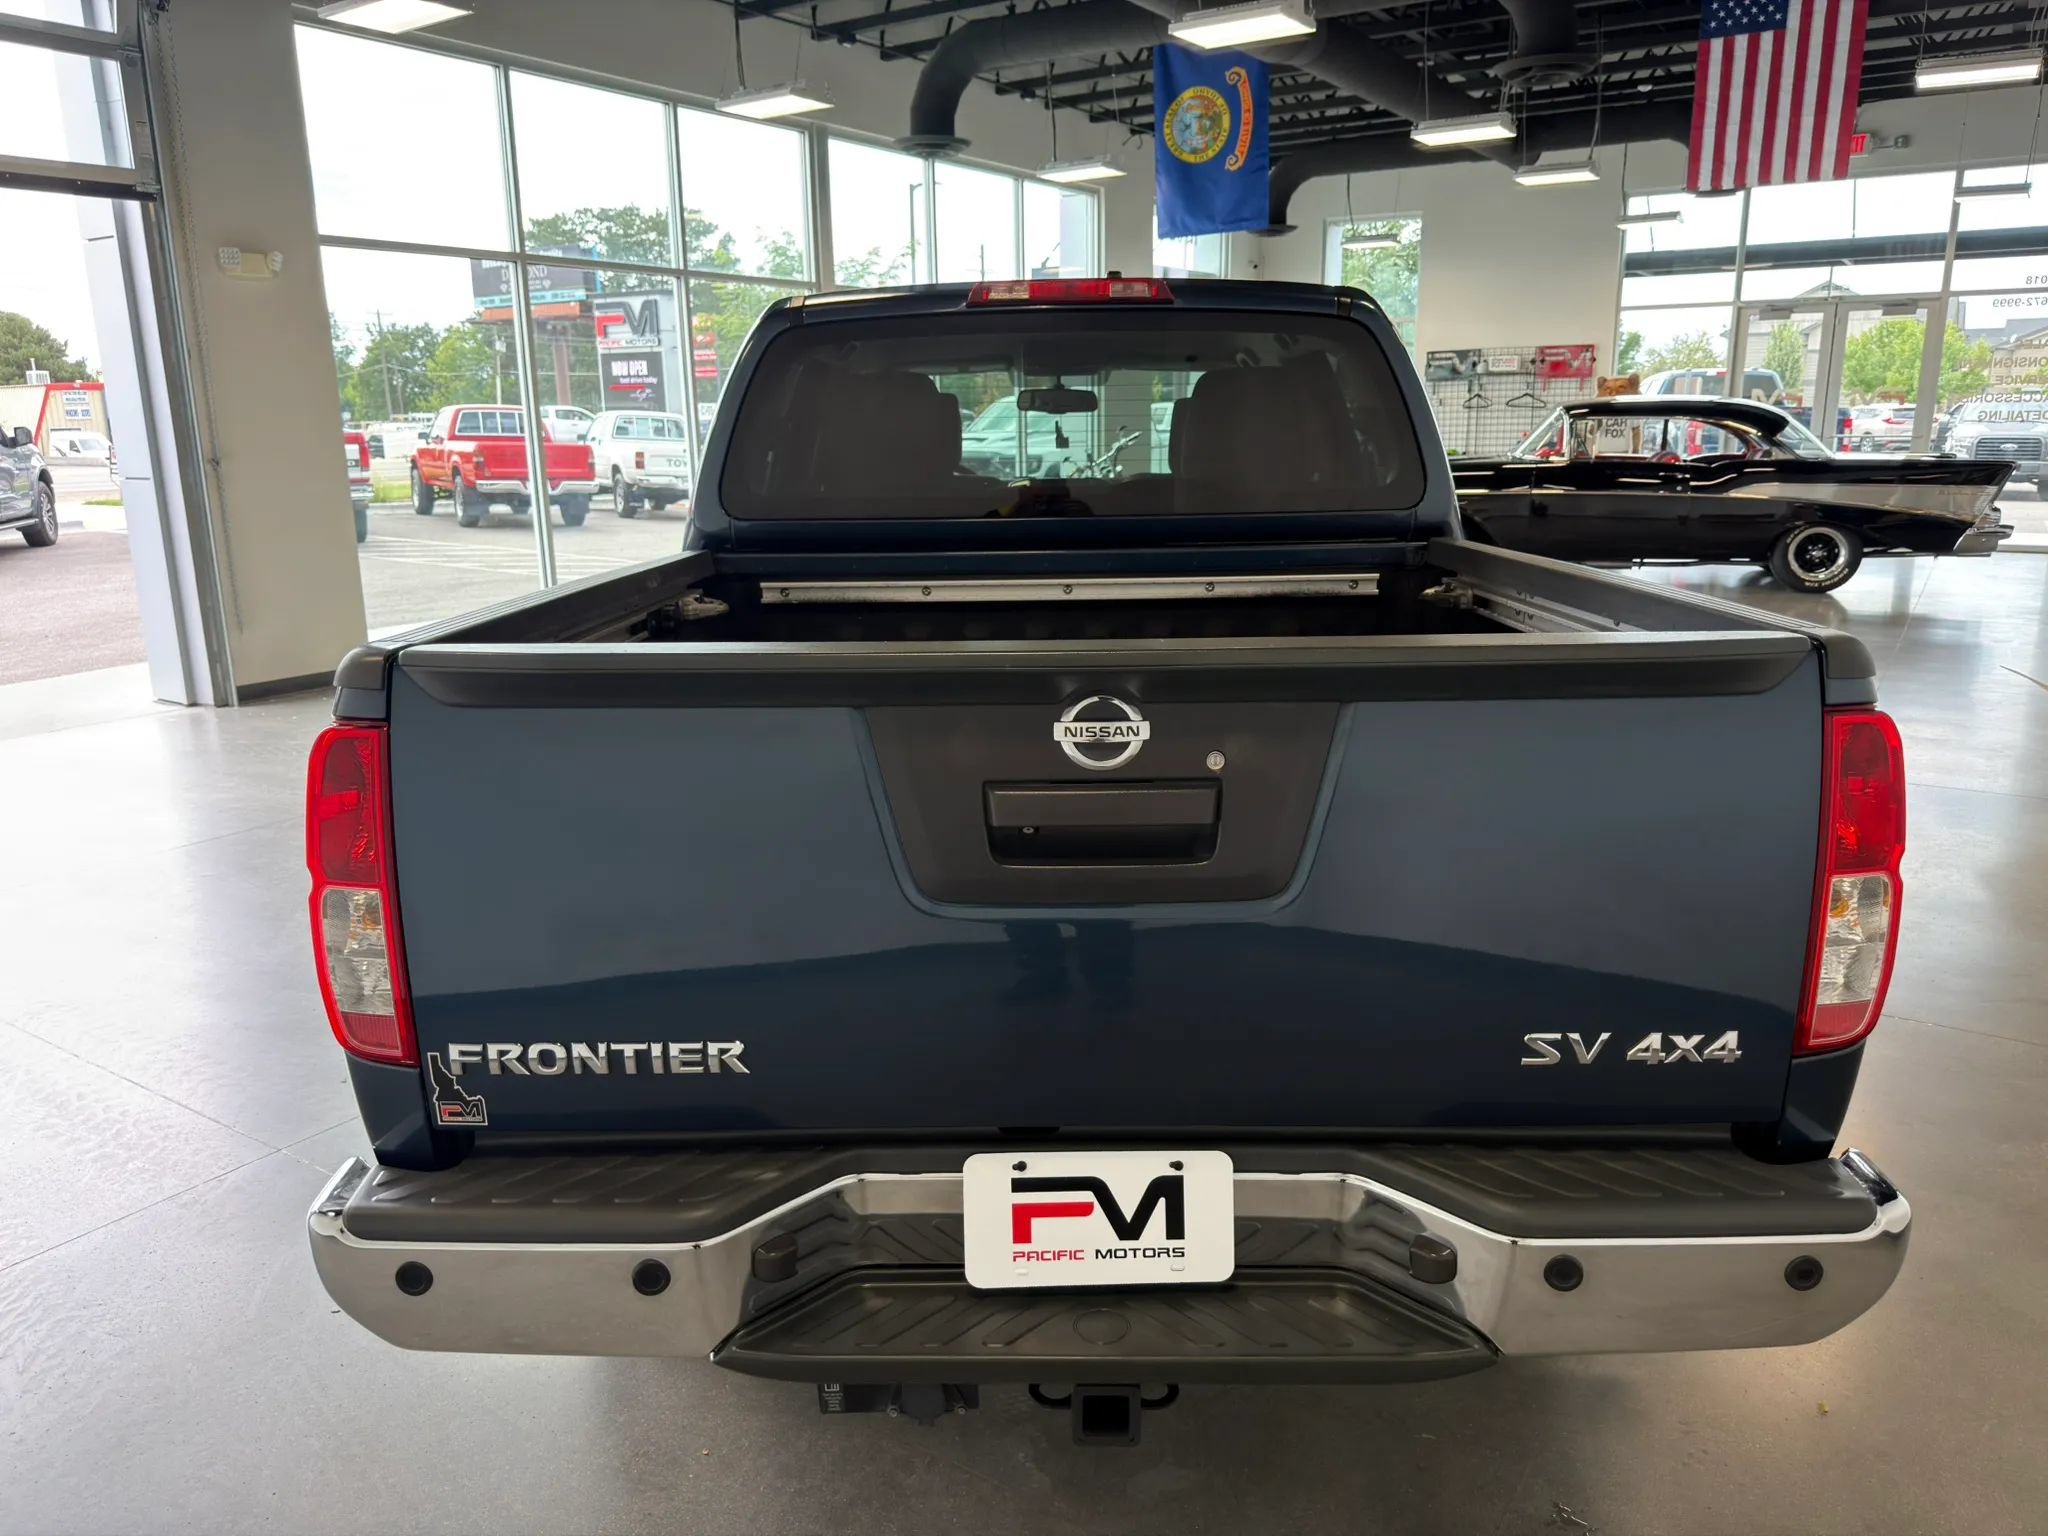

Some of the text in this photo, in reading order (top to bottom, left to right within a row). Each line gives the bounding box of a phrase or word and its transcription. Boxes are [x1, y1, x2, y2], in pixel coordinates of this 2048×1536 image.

[629, 360, 648, 376] OPEN
[1605, 428, 1626, 438] FOX
[1064, 725, 1140, 738] NISSAN
[1520, 1030, 1743, 1065] SV 4x4
[448, 1040, 750, 1075] FRONTIER
[1012, 1247, 1185, 1262] PACIFIC MOTORS
